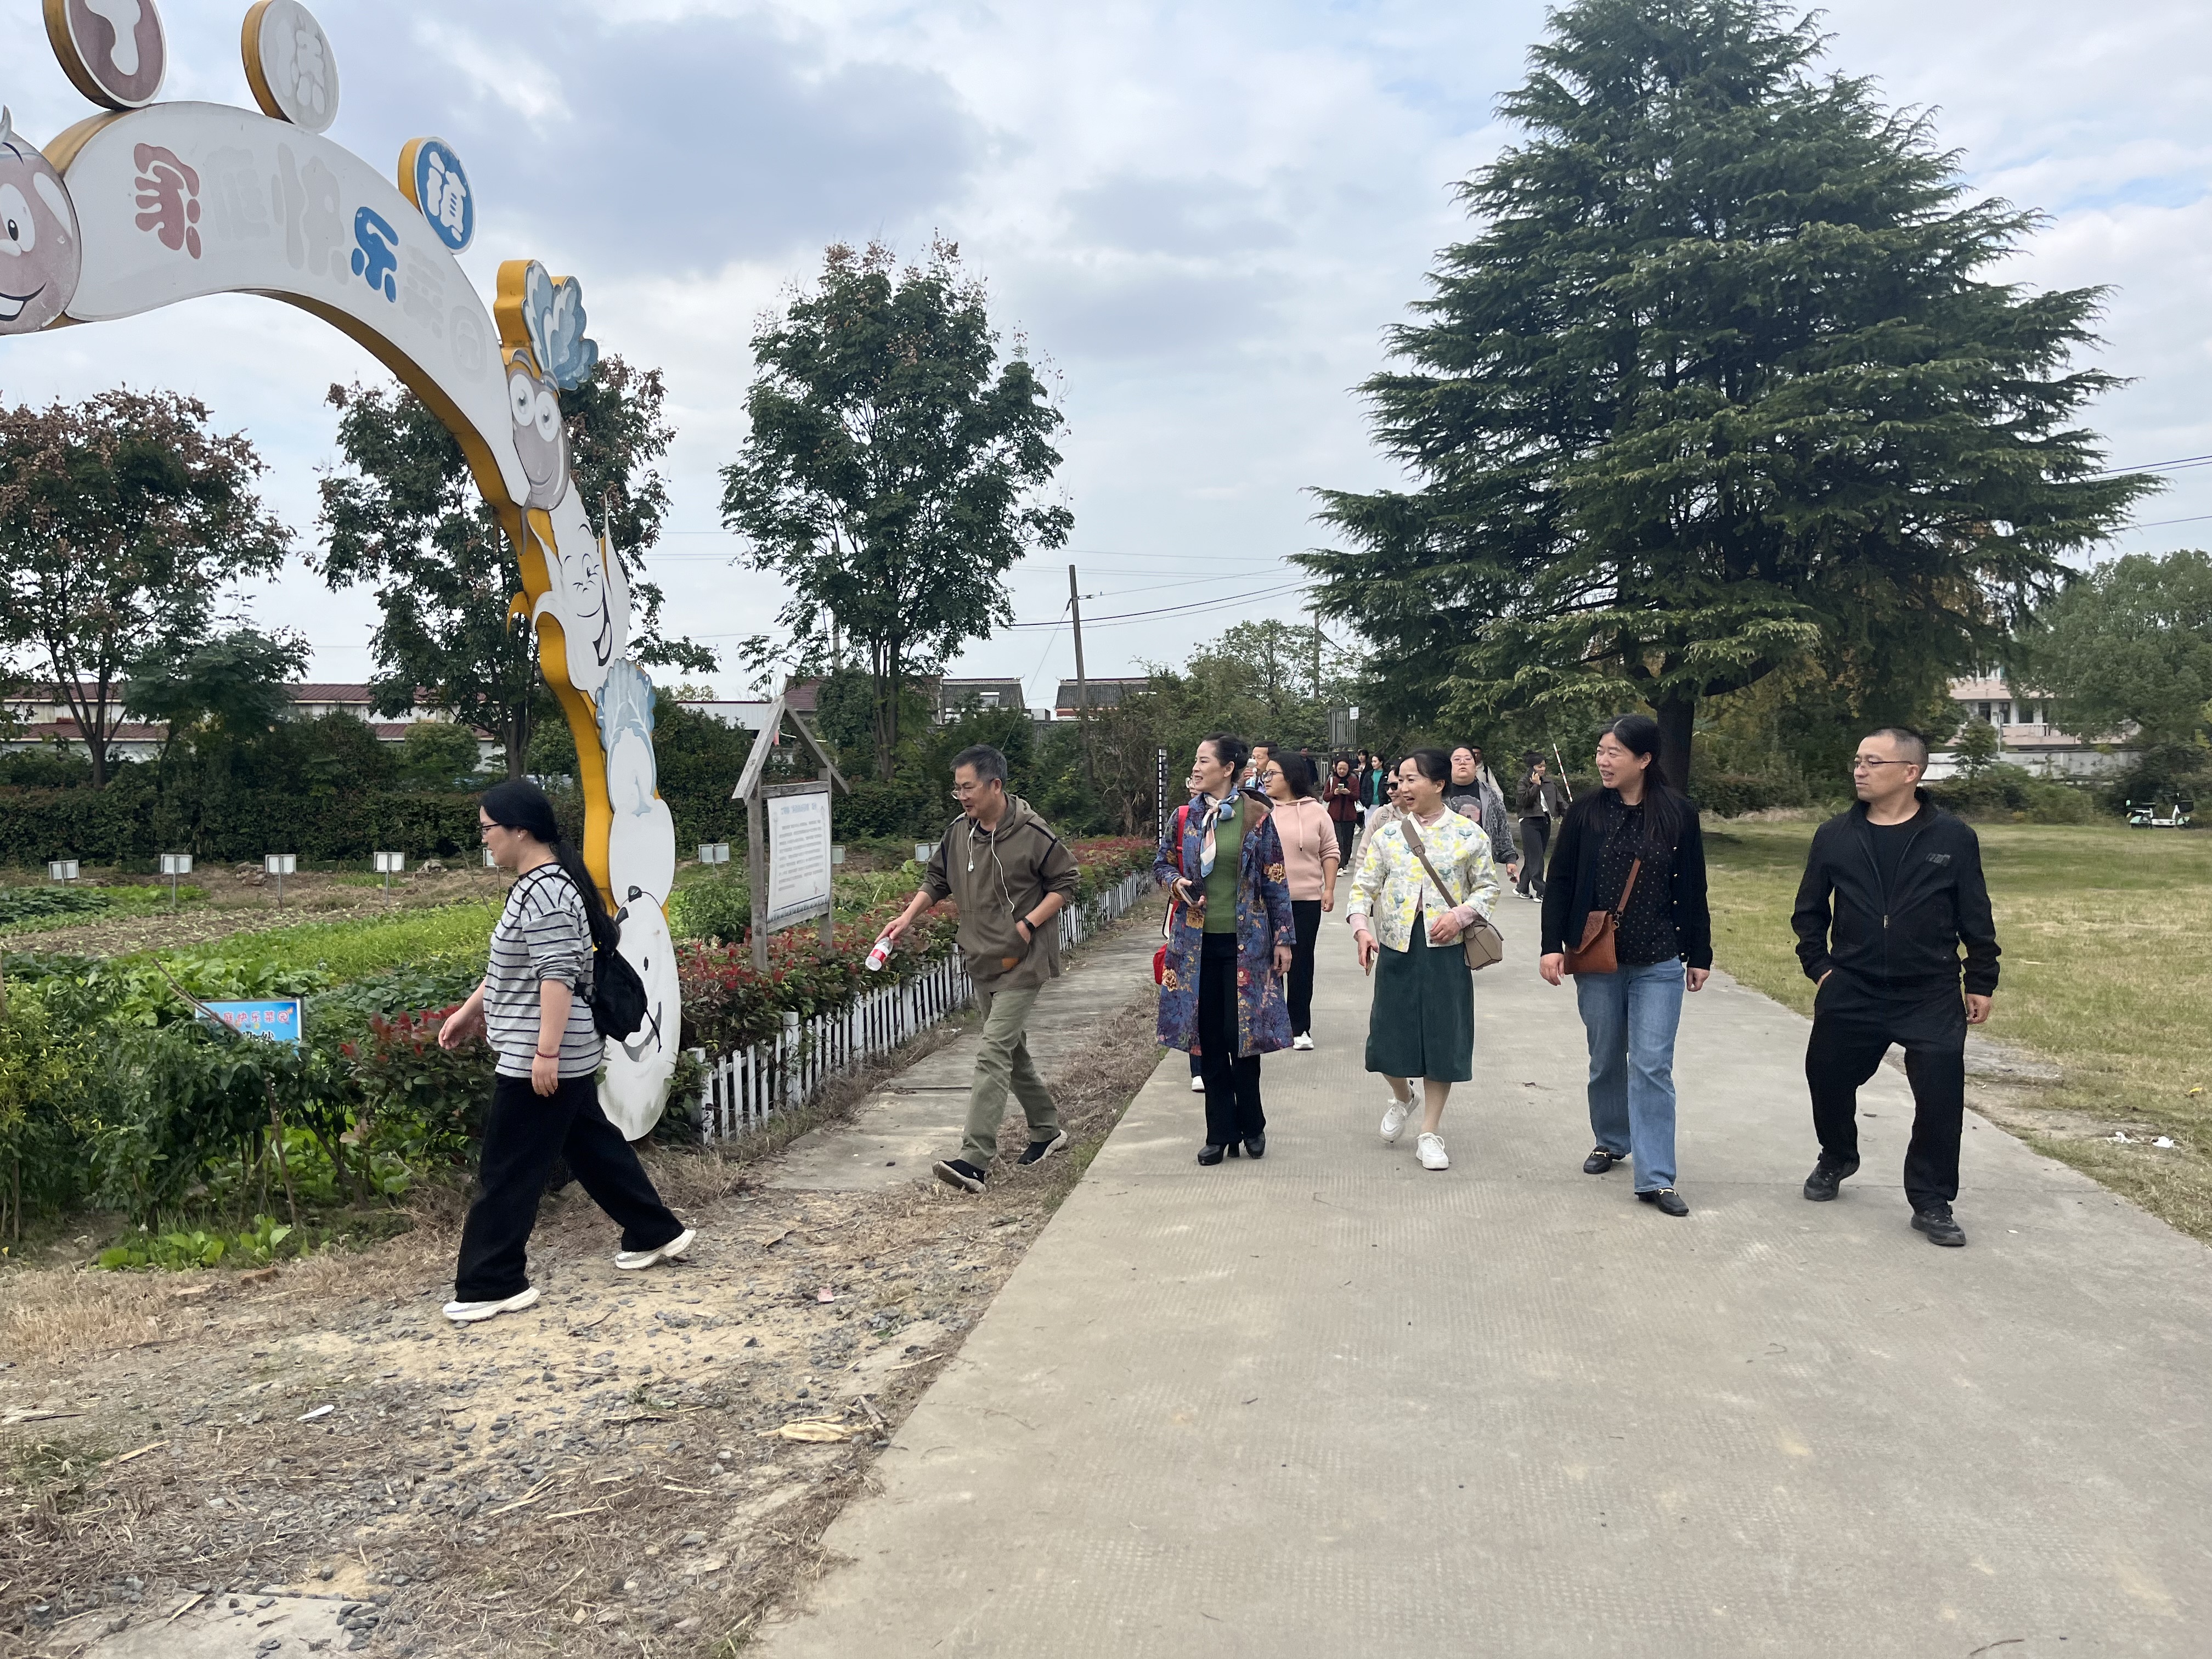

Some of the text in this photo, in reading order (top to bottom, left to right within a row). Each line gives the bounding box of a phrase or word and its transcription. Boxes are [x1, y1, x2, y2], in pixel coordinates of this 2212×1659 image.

[211, 1012, 289, 1023] 庭快乐菜园
